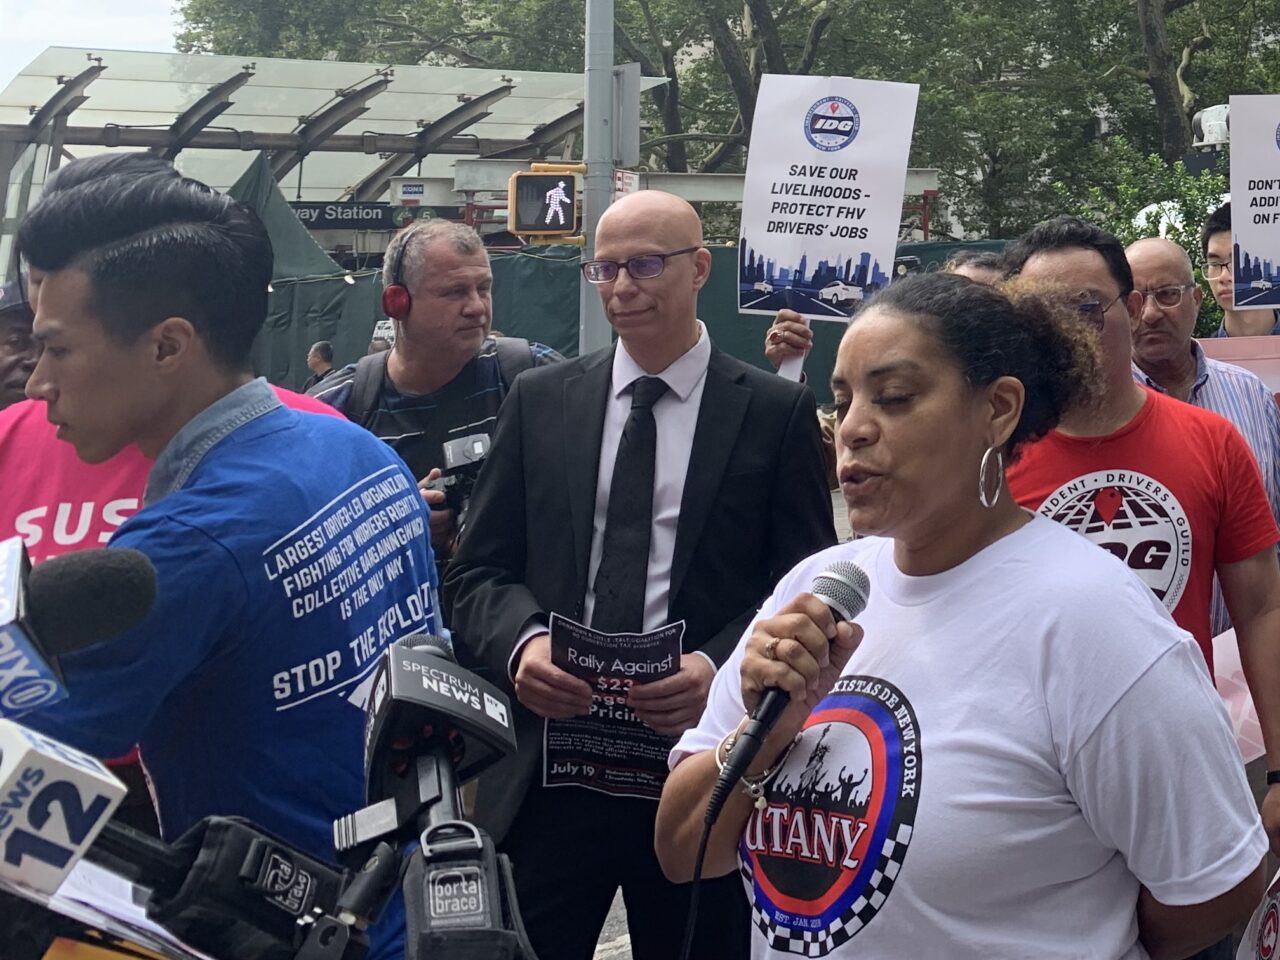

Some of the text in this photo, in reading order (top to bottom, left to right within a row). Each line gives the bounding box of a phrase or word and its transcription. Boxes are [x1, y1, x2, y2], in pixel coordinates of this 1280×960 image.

[814, 118, 853, 131] IDG
[789, 164, 858, 181] SAVE OUR
[771, 182, 861, 200] LIVELIHOODS
[324, 205, 382, 220] Station
[771, 201, 866, 220] PROTECT FHV
[1253, 213, 1270, 224] ON
[829, 226, 868, 239] JOBS
[1106, 473, 1191, 567] DRIVERS GUILD
[264, 525, 327, 581] LARGEST
[283, 546, 342, 598] FIGHTING
[338, 535, 356, 560] FOR
[386, 497, 412, 523] RIGHT
[292, 561, 362, 619] COLLECTIVE
[340, 555, 404, 620] IS THE ONLY WAY
[273, 650, 342, 700] STOP
[350, 625, 376, 668] THE
[568, 647, 673, 675] Rally Against
[402, 660, 480, 697] SPECTRUM
[597, 676, 634, 691] $23
[422, 675, 482, 710] NEWS
[486, 696, 498, 707] NY
[878, 687, 917, 798] DE NEW YORK
[550, 761, 595, 776] July 19
[4, 780, 113, 870] 12
[435, 880, 478, 898] porta
[435, 895, 478, 914] brace
